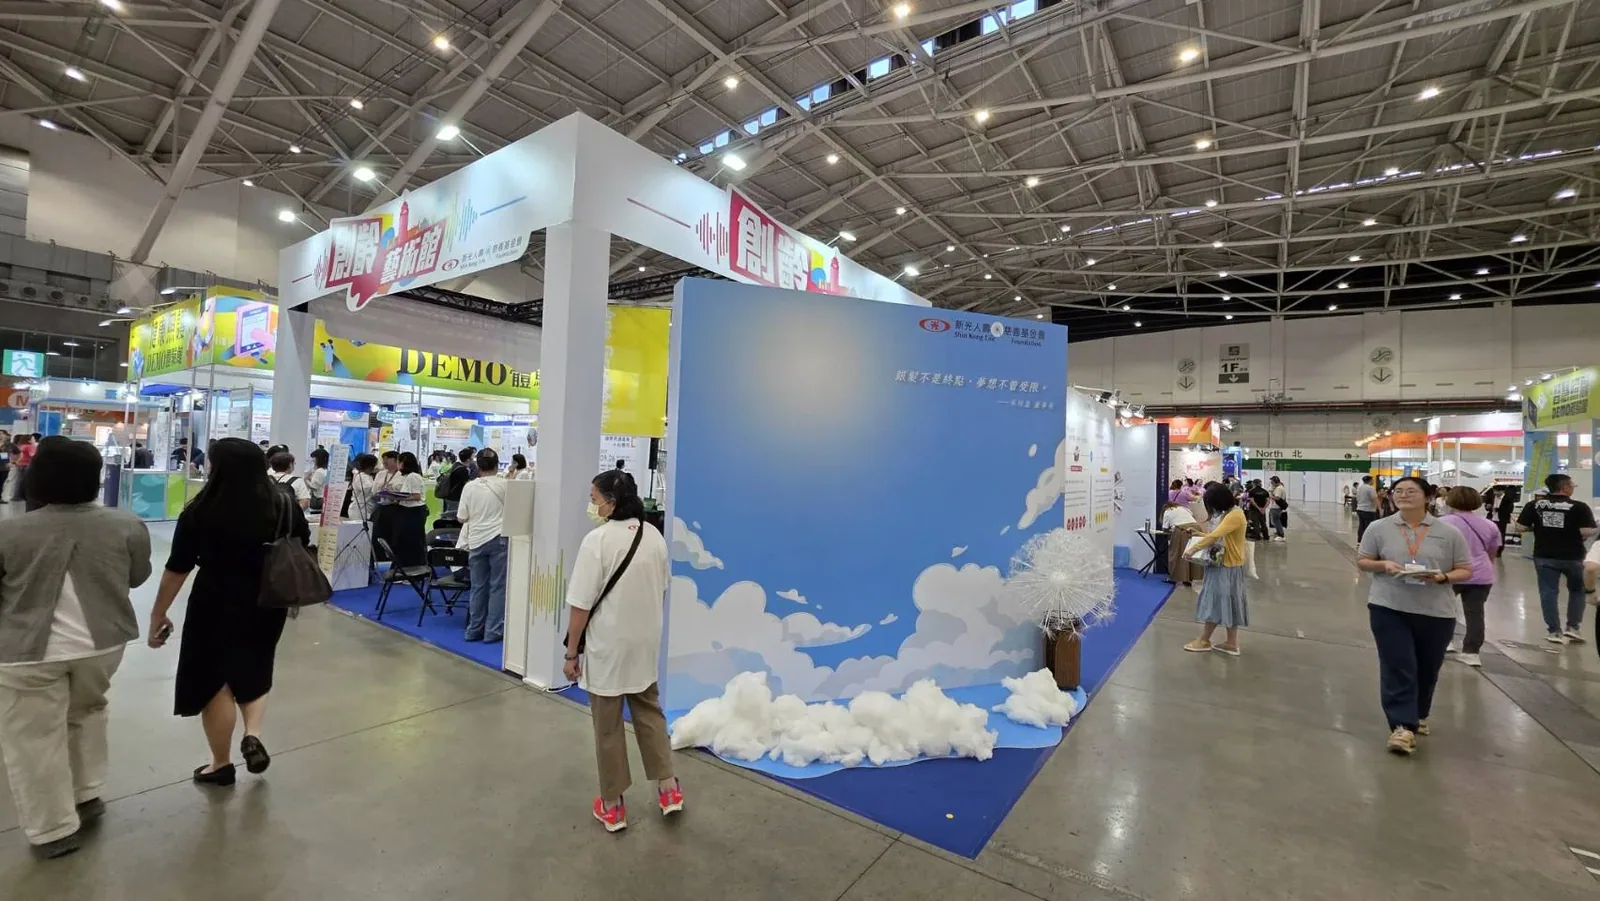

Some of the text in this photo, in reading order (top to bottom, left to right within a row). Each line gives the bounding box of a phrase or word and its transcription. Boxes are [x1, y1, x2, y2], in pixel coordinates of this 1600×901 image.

[380, 224, 442, 284] 藝術館
[1221, 363, 1239, 373] 1F
[1256, 450, 1283, 458] North
[1292, 450, 1302, 458] 北
